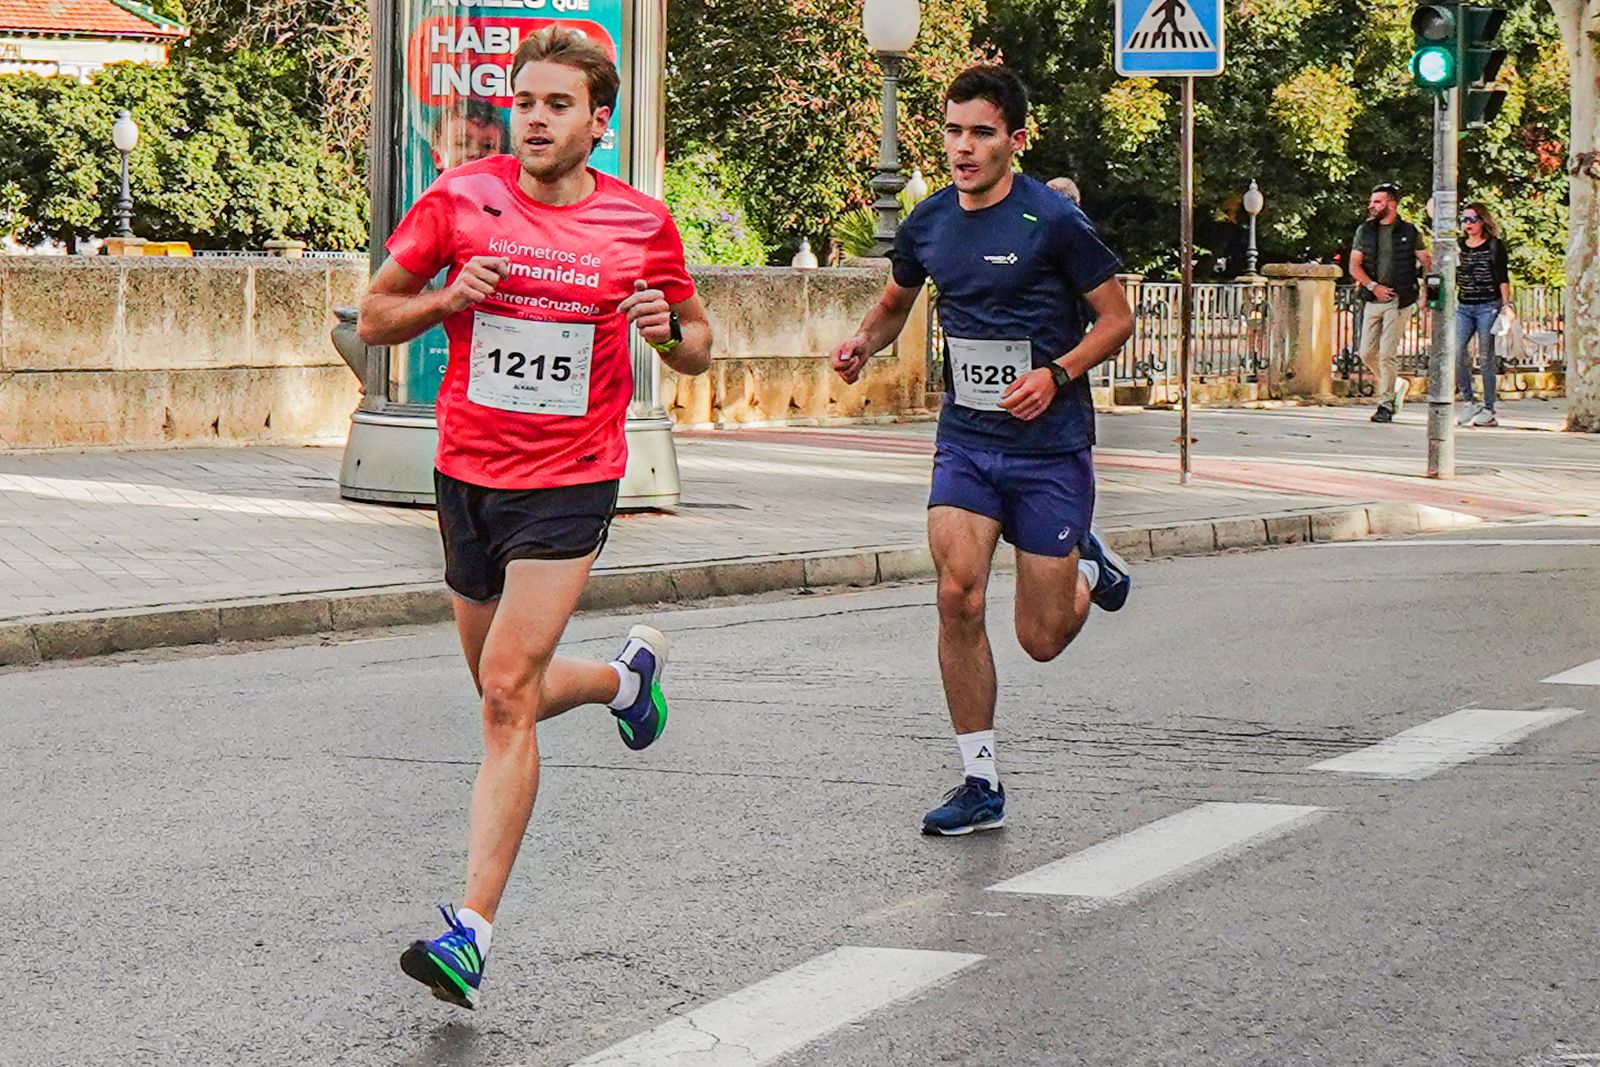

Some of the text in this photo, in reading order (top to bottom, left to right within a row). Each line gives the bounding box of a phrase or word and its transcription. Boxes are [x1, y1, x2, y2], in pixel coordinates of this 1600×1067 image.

[488, 238, 601, 268] kilómetros de
[507, 263, 600, 288] manidad
[488, 348, 572, 382] 1215
[961, 363, 1018, 385] 1528
